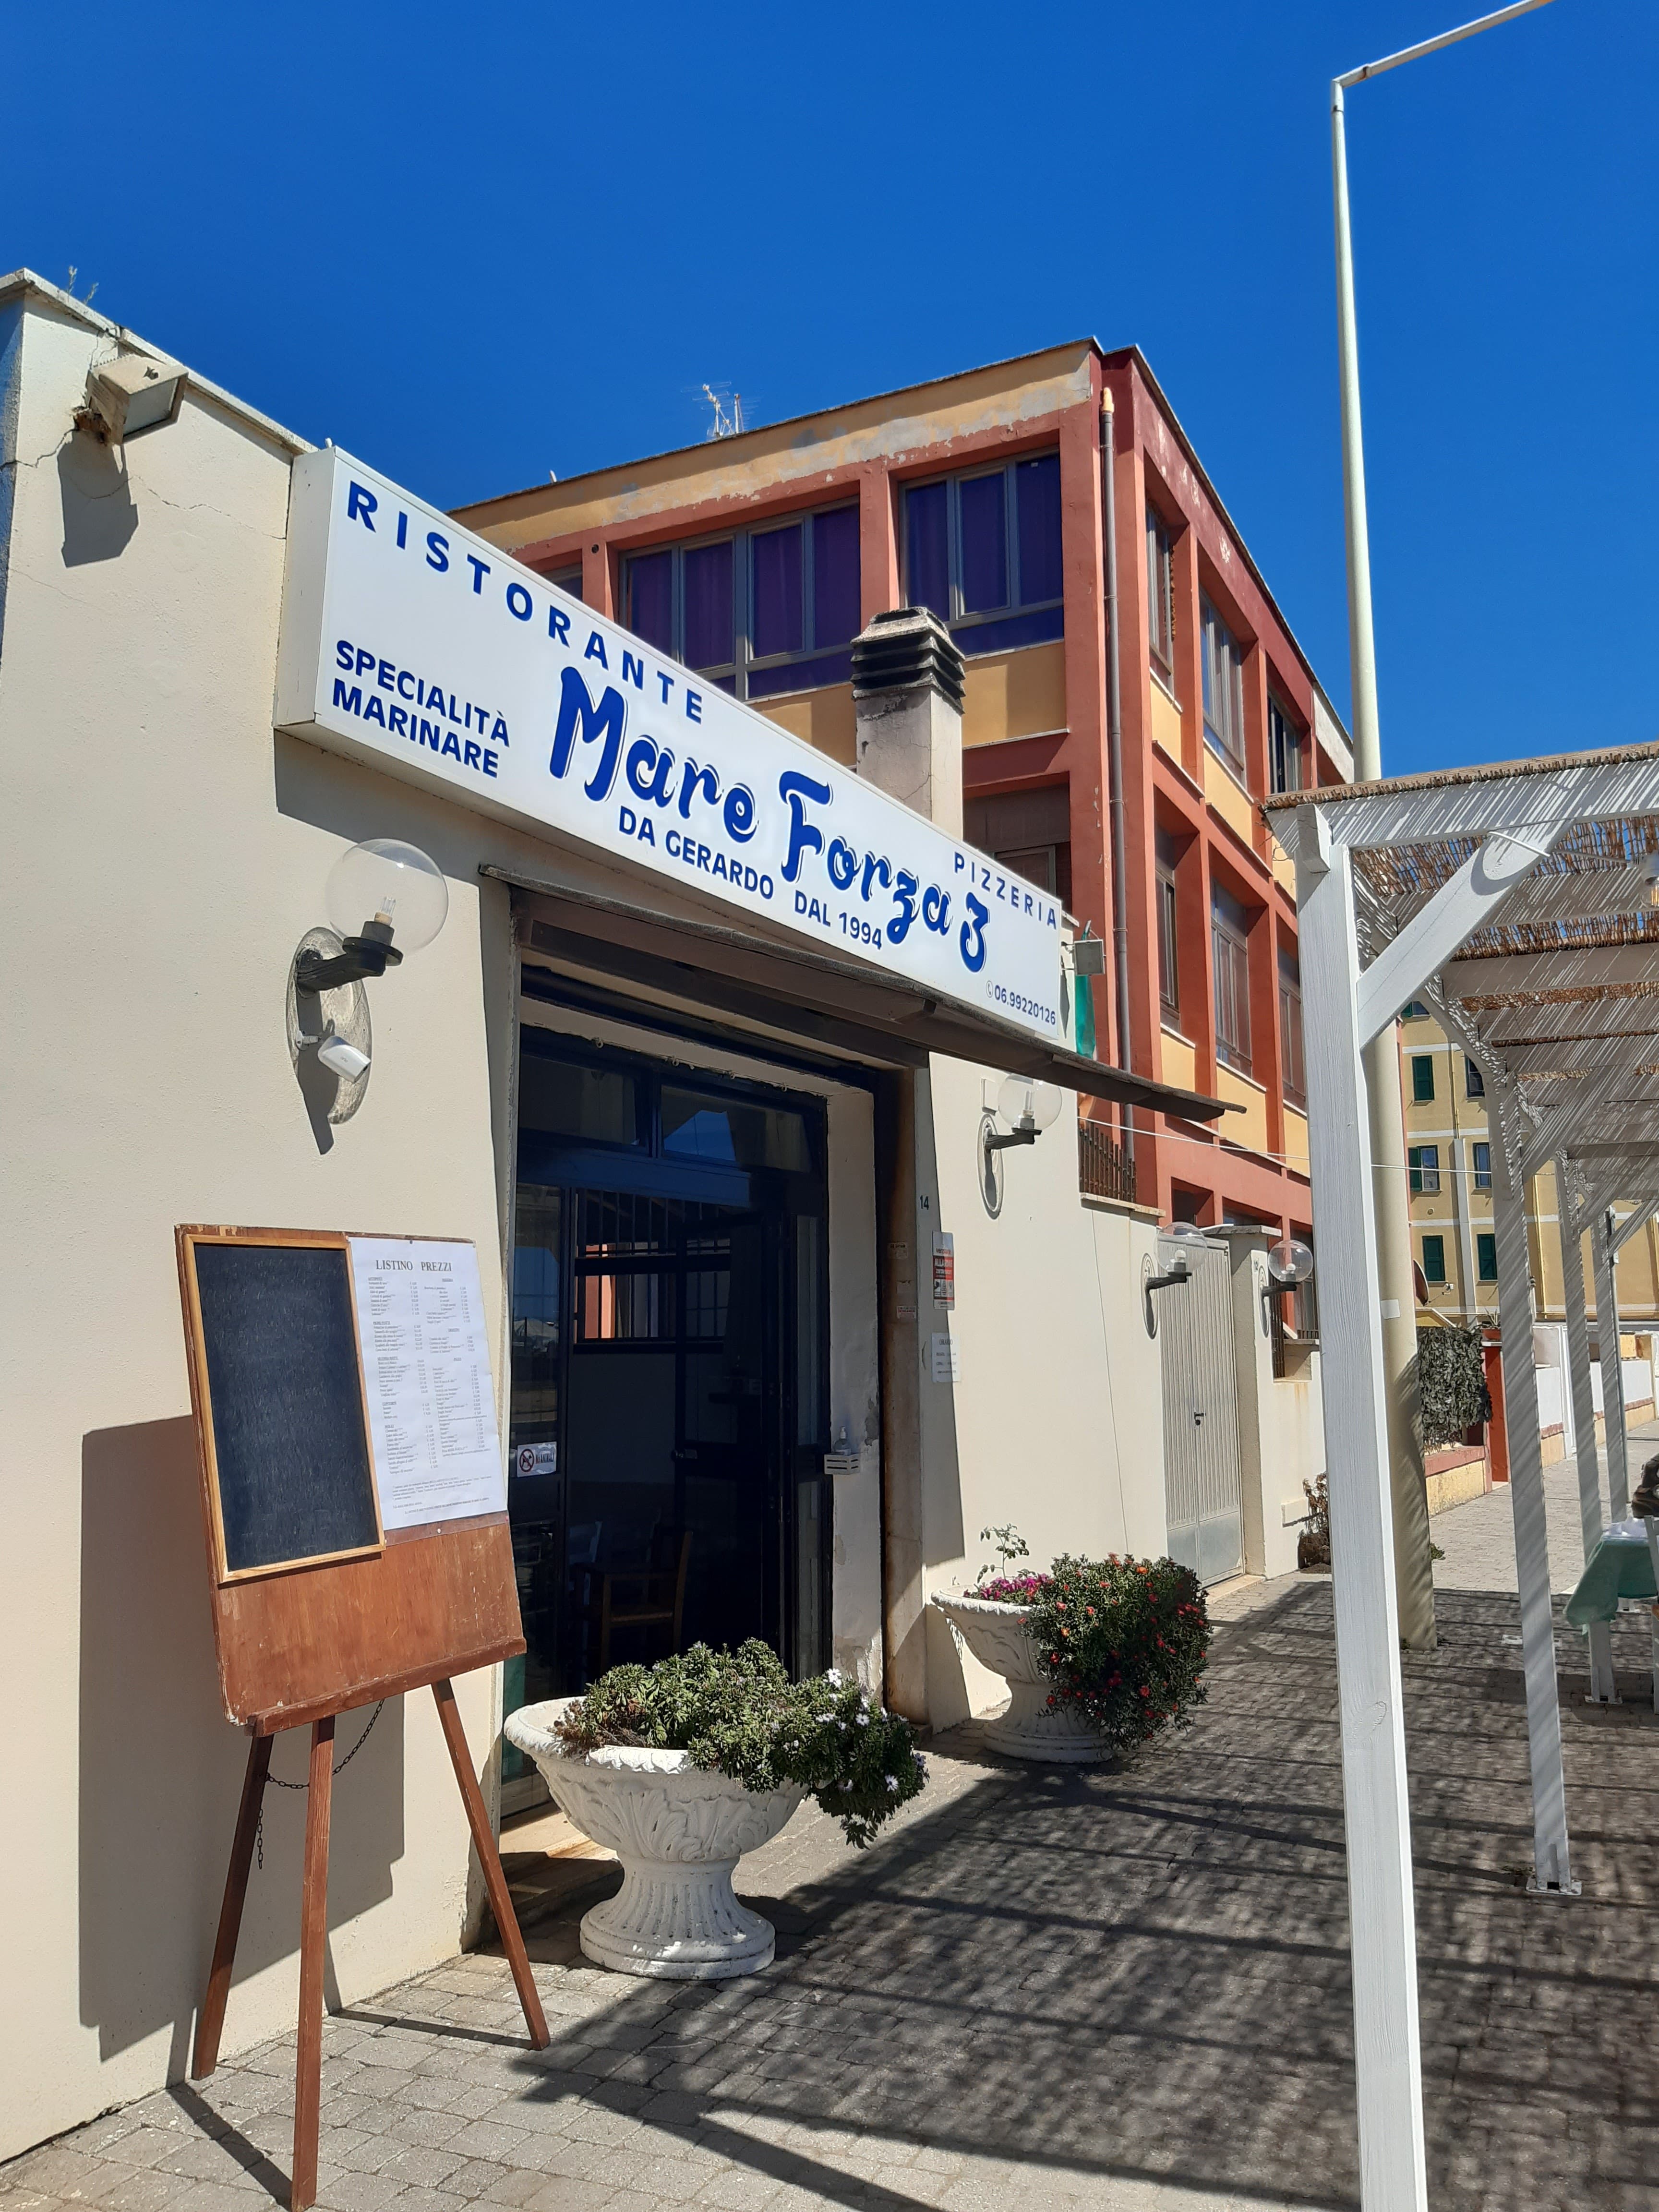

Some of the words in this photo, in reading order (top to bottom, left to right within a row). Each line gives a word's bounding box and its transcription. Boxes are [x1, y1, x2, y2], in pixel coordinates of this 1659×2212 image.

[347, 480, 703, 725] RISTORANTE
[332, 677, 499, 779] MARINARE
[336, 639, 510, 748] SPECIALITÀ
[549, 666, 758, 844] Mare
[779, 770, 952, 945] Forza
[959, 891, 991, 973] 3
[619, 805, 656, 847] DA
[665, 830, 774, 900] GERARDO
[794, 890, 831, 927] DAL
[839, 912, 882, 950] 1994
[954, 851, 1057, 930] PIZZERIA
[994, 984, 1056, 1026] 06.99220126
[919, 1195, 929, 1210] 14
[376, 1260, 413, 1271] LISTINO
[421, 1262, 452, 1272] PREZZI
